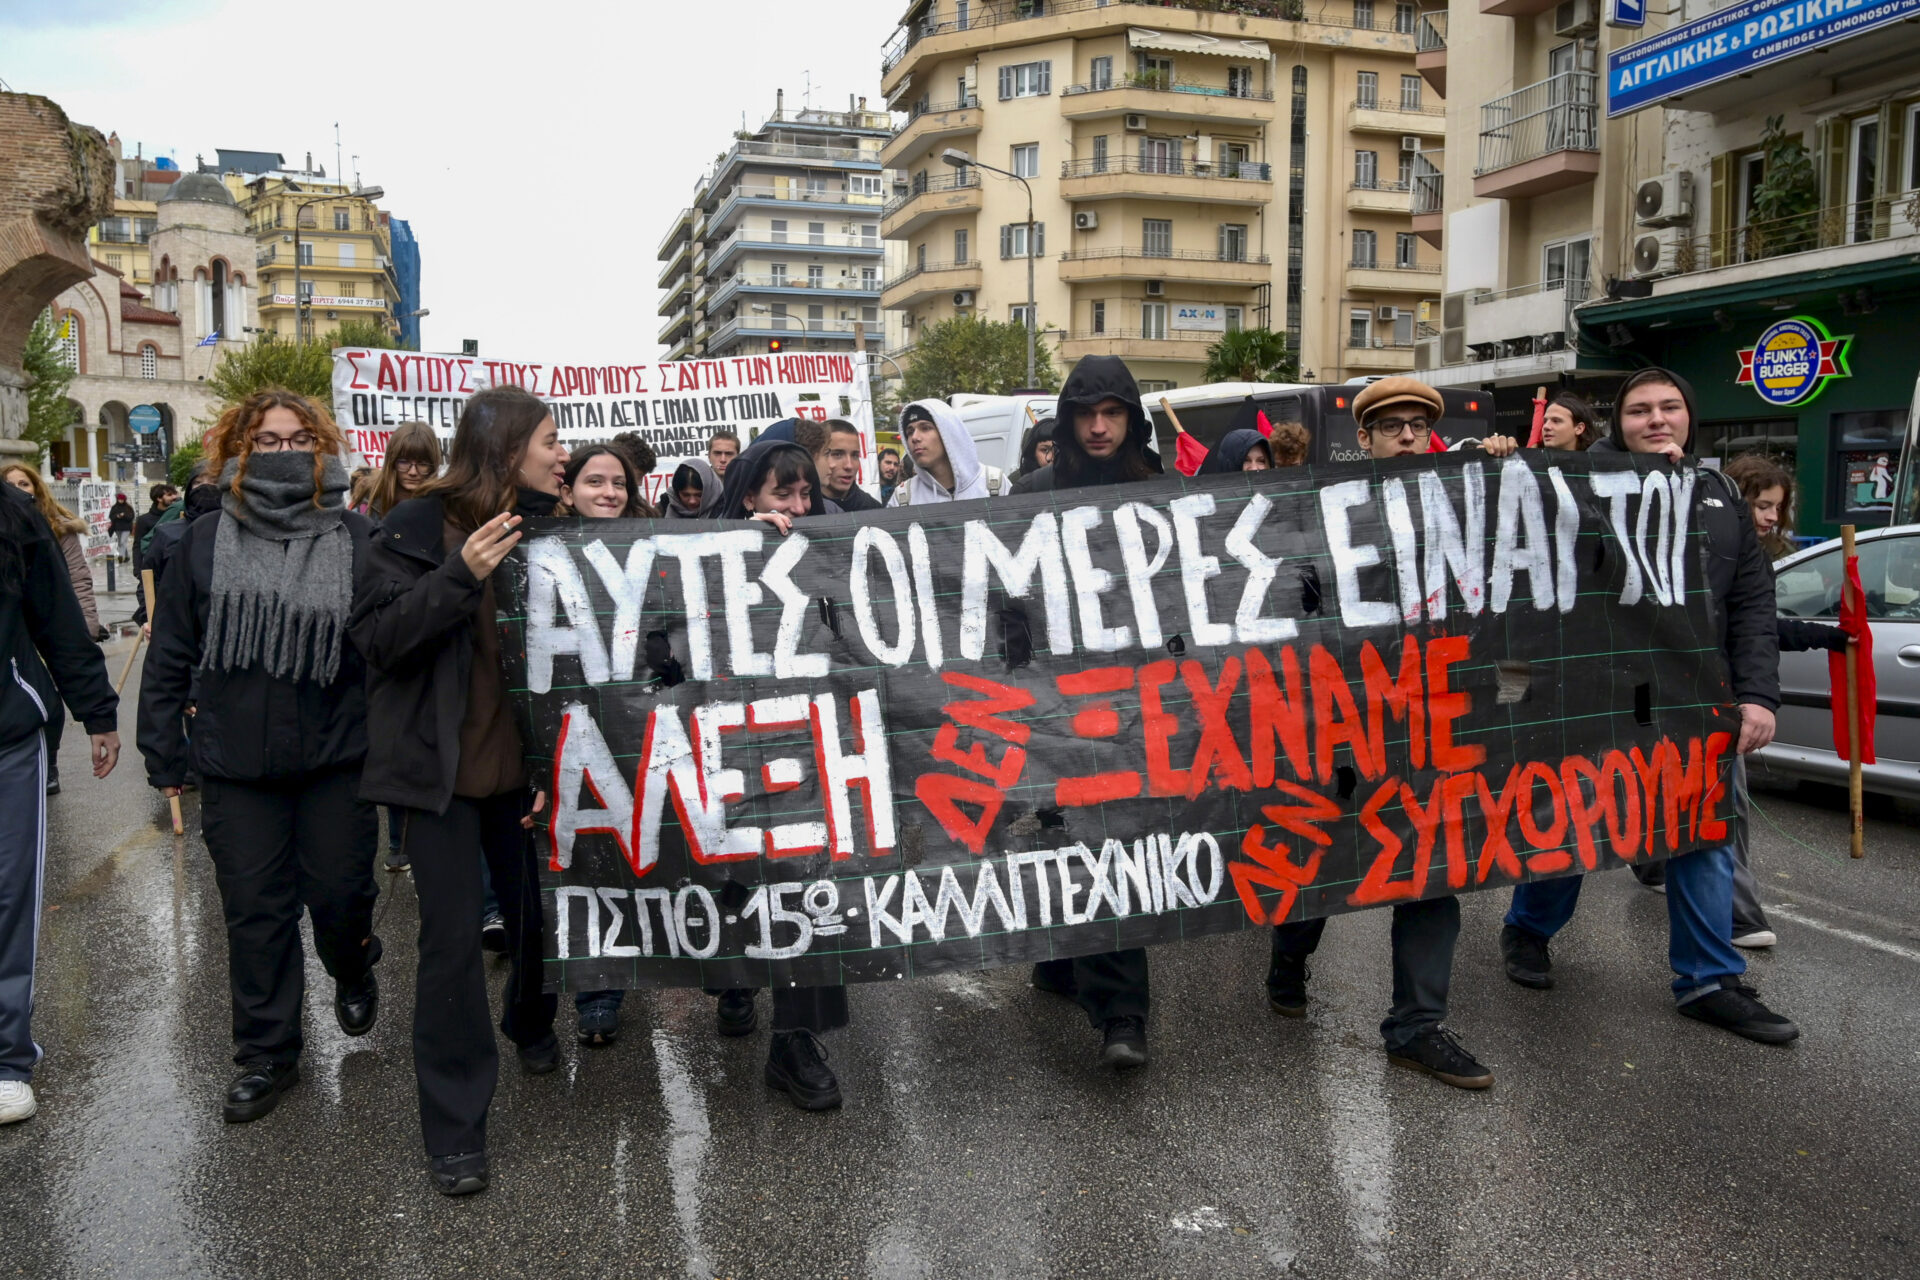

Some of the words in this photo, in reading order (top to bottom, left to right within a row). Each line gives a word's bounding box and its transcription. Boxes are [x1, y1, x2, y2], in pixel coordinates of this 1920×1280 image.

[1619, 30, 1689, 64] ΠΙΣΤΟΠΟΙΗΜΕΝΟΣ
[1691, 6, 1751, 37] ΕΞΕΤΑΣΤΙΚΟΣ
[1752, 30, 1816, 60] CAMBRIDGE
[1827, 1, 1900, 34] LOMONOSOV
[1618, 32, 1727, 91] ΑΓΓΛΙΚΗΣ
[1731, 36, 1741, 50] &
[550, 365, 648, 397] ΔΡΟΜΟΥΣ
[731, 356, 774, 386] ΤΗΝ
[776, 354, 854, 384] ΚΟΙΝΩΝΙΑ
[1759, 361, 1810, 379] BURGER
[1763, 348, 1807, 365] FUNKY
[610, 400, 649, 427] ΔΕΝ
[652, 398, 700, 426] ΕΙΝΑΙ
[703, 391, 783, 422] ΟΥΤΟΠΙΑ
[525, 528, 831, 694] ΑΥΤΕΣ
[849, 522, 944, 671] ΟΙ
[959, 492, 1299, 662] ΜΕΡΕΣ
[1319, 454, 1580, 628] ΕΙΝΑΙ
[1588, 466, 1695, 607] ΤΟΥ
[914, 671, 1037, 854] ΔΕΝ
[1055, 634, 1487, 807] ΞΕΧΝΑΜΕ
[548, 688, 898, 878] ΑΛΕΞΗ
[1227, 779, 1342, 926] ΔΕΝ
[1347, 731, 1736, 906] ΣΥΓΧΩΡΟΥΜΕ
